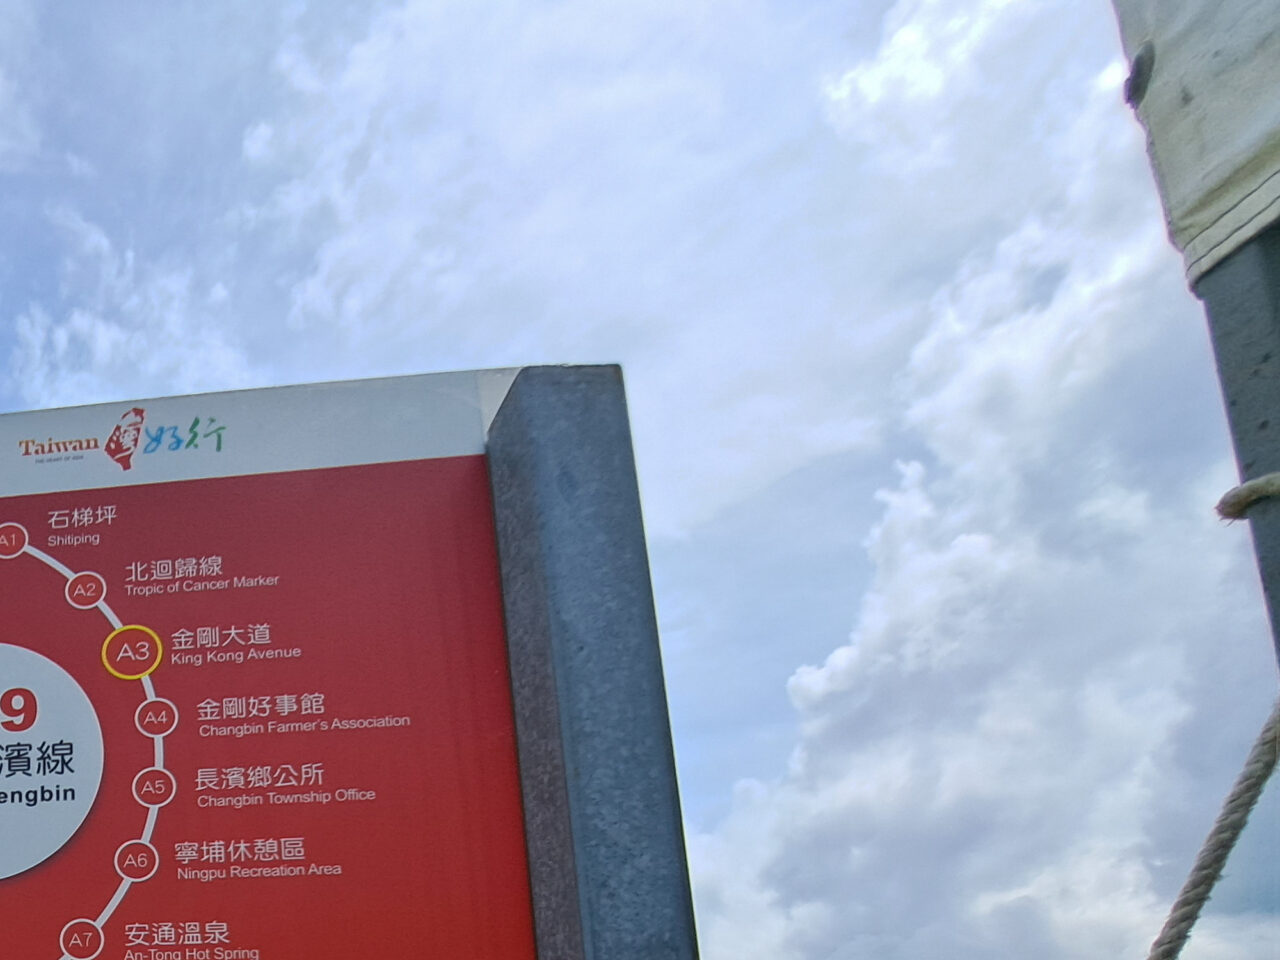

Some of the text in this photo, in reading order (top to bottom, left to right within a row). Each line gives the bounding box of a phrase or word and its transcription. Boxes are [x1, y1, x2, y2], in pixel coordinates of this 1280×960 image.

[19, 436, 99, 456] Taiwan
[48, 505, 117, 529] 石梯坪
[48, 534, 100, 547] Shitiping
[124, 556, 223, 582] 北迴歸線
[73, 583, 96, 597] A2
[125, 574, 279, 597] Tropic of Cancer Marker
[171, 623, 271, 650] 金剛大道
[116, 642, 150, 662] A3
[171, 647, 302, 667] King Kong Avenue
[197, 692, 325, 721] 金剛好事館
[144, 711, 168, 724] A4
[199, 715, 410, 738] Changbin Farmer's Association
[195, 763, 324, 791] 長濱鄉公所
[141, 781, 165, 795] A5
[197, 788, 376, 809] Changbin Township Office
[124, 853, 148, 868] A6
[174, 837, 305, 864] 寧埔休憩區
[177, 863, 342, 882] Ningpu Recreation Area
[69, 934, 91, 948] A7
[124, 921, 230, 947] 安通溫泉
[185, 948, 210, 960] Hot
